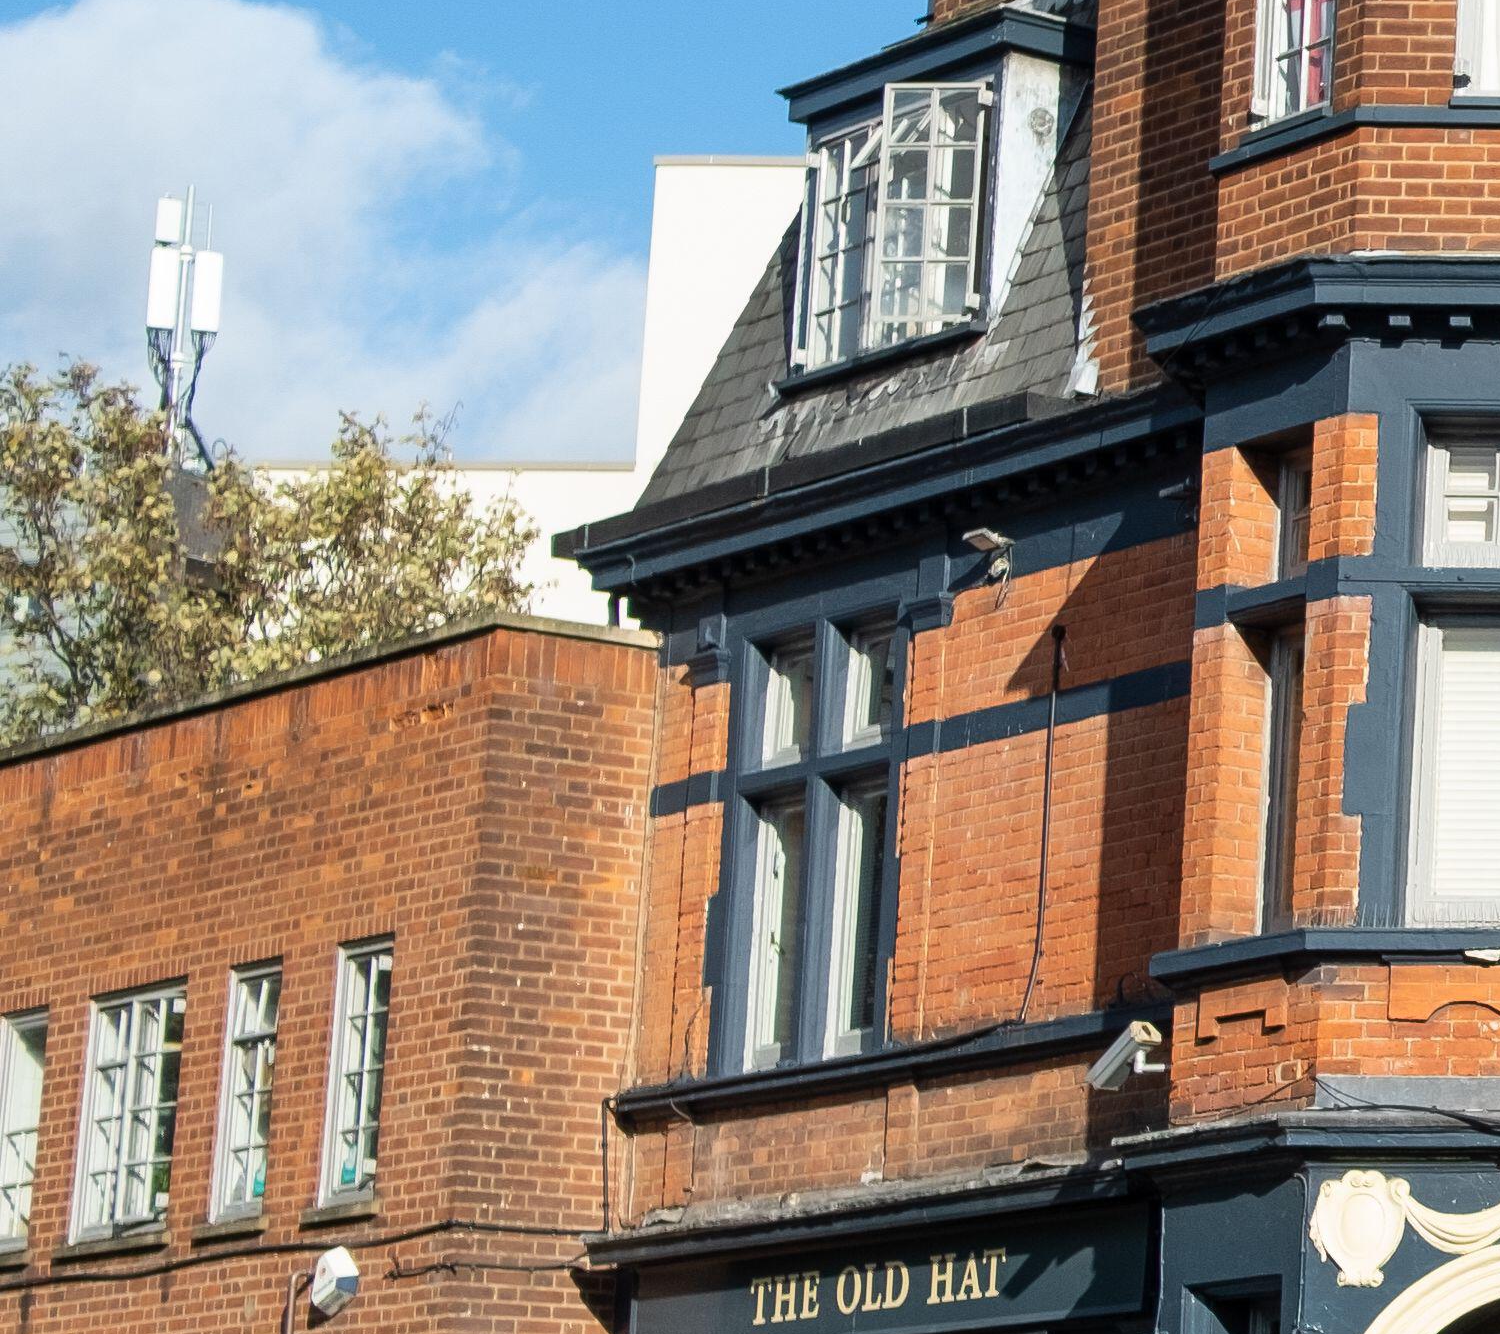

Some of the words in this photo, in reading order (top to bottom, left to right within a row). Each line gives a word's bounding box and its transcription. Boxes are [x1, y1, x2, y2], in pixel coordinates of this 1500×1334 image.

[750, 1271, 820, 1326] THE
[836, 1261, 910, 1315] OLD
[926, 1248, 1007, 1304] HAT
